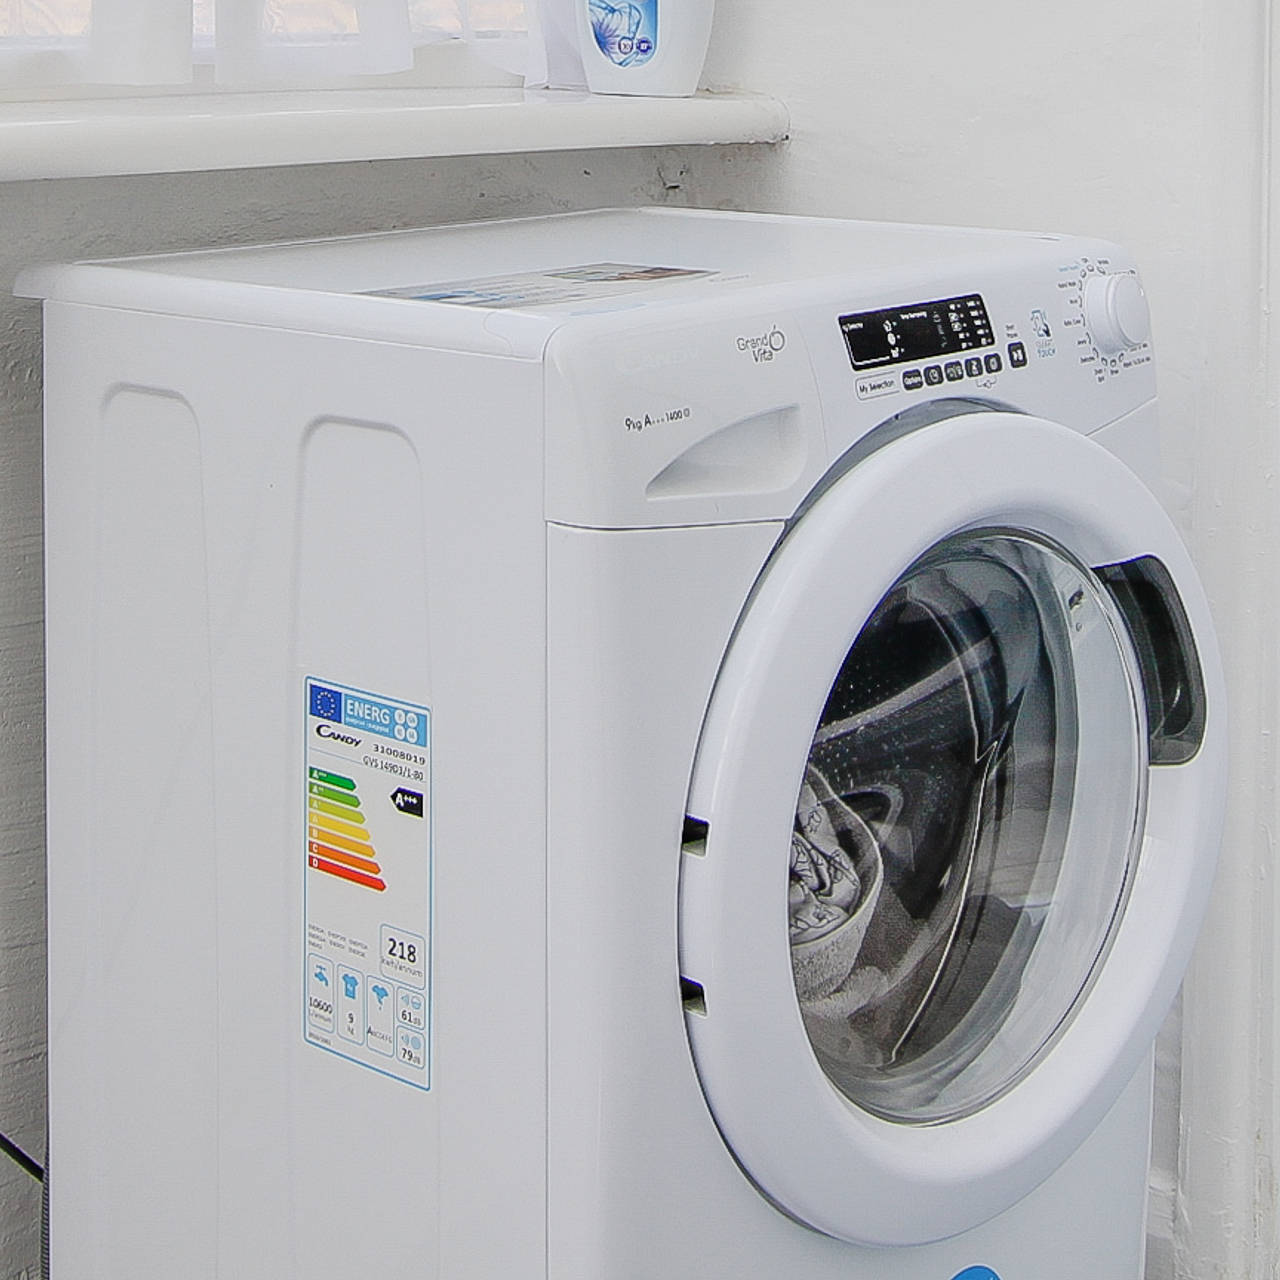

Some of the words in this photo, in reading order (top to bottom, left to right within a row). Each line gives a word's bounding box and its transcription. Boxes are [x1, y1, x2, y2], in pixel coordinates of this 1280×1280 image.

[346, 699, 390, 724] ENERG
[316, 724, 361, 747] CANDY
[388, 937, 417, 964] 218
